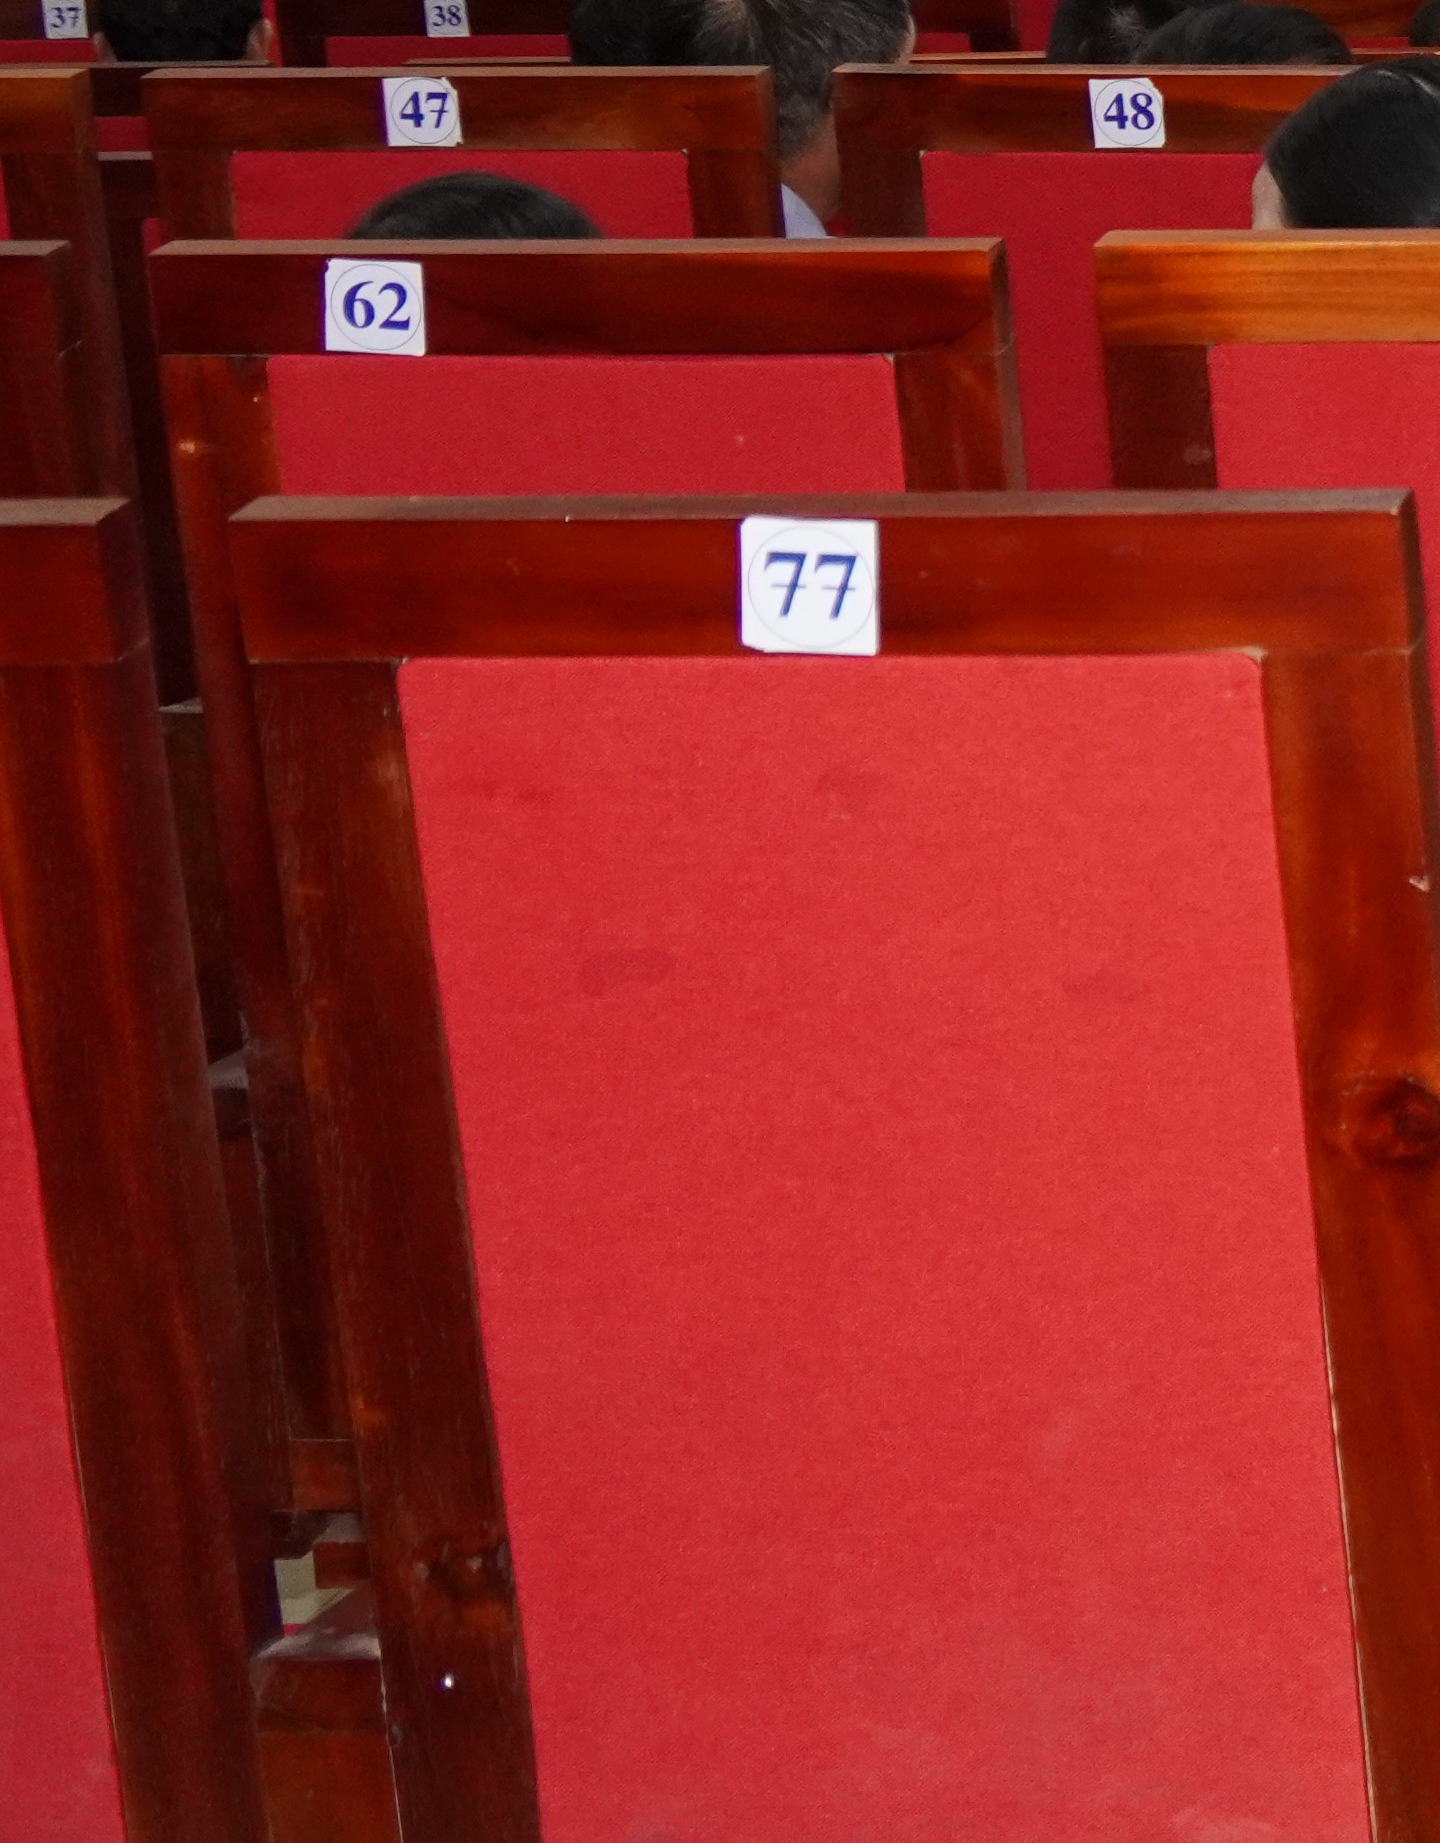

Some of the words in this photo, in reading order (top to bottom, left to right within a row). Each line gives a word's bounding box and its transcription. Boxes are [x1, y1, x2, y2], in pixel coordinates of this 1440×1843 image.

[50, 6, 81, 29] 37
[430, 3, 464, 28] 38
[398, 90, 450, 130] 47
[1102, 91, 1156, 132] 48
[342, 280, 411, 331] 62
[765, 551, 858, 619] 77
